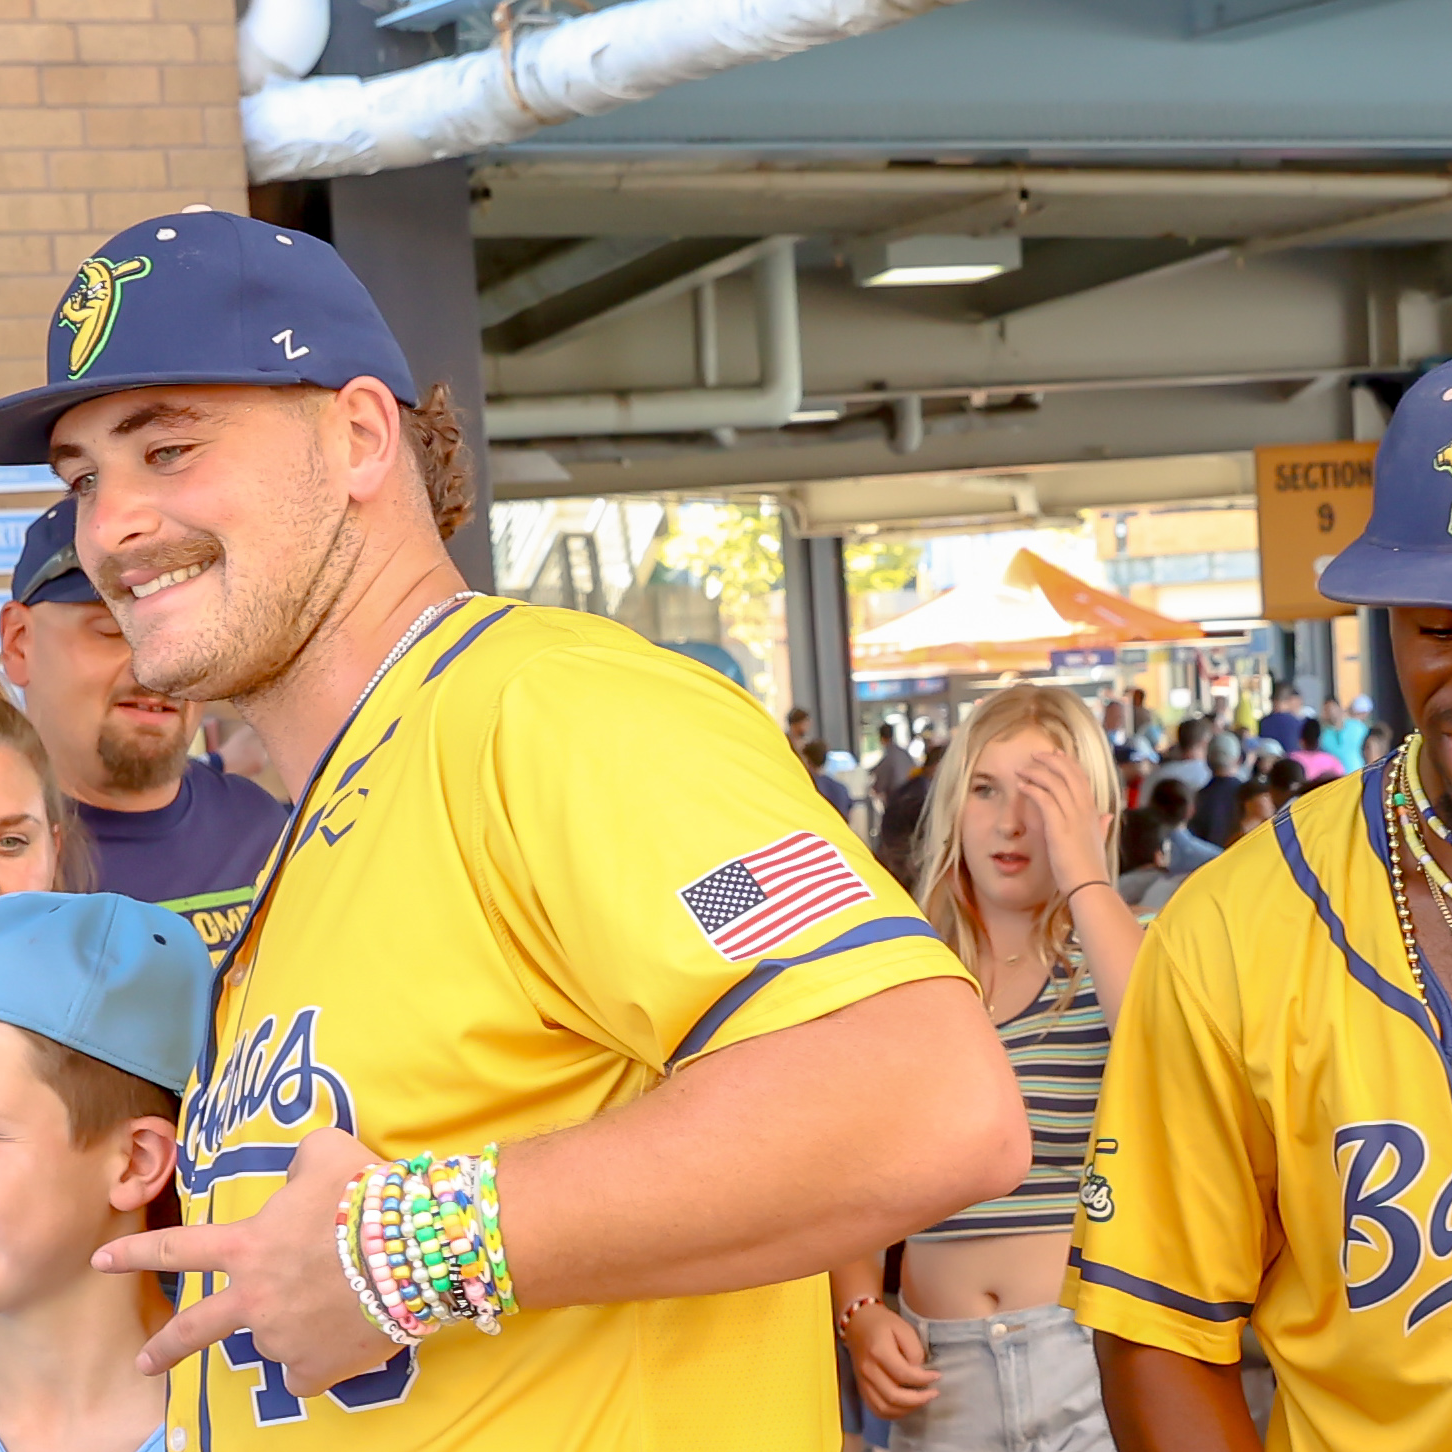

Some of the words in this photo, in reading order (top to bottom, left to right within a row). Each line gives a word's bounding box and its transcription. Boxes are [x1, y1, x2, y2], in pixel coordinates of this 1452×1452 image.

[272, 329, 309, 360] Z
[1275, 460, 1374, 491] SECTION
[1317, 503, 1335, 532] 9
